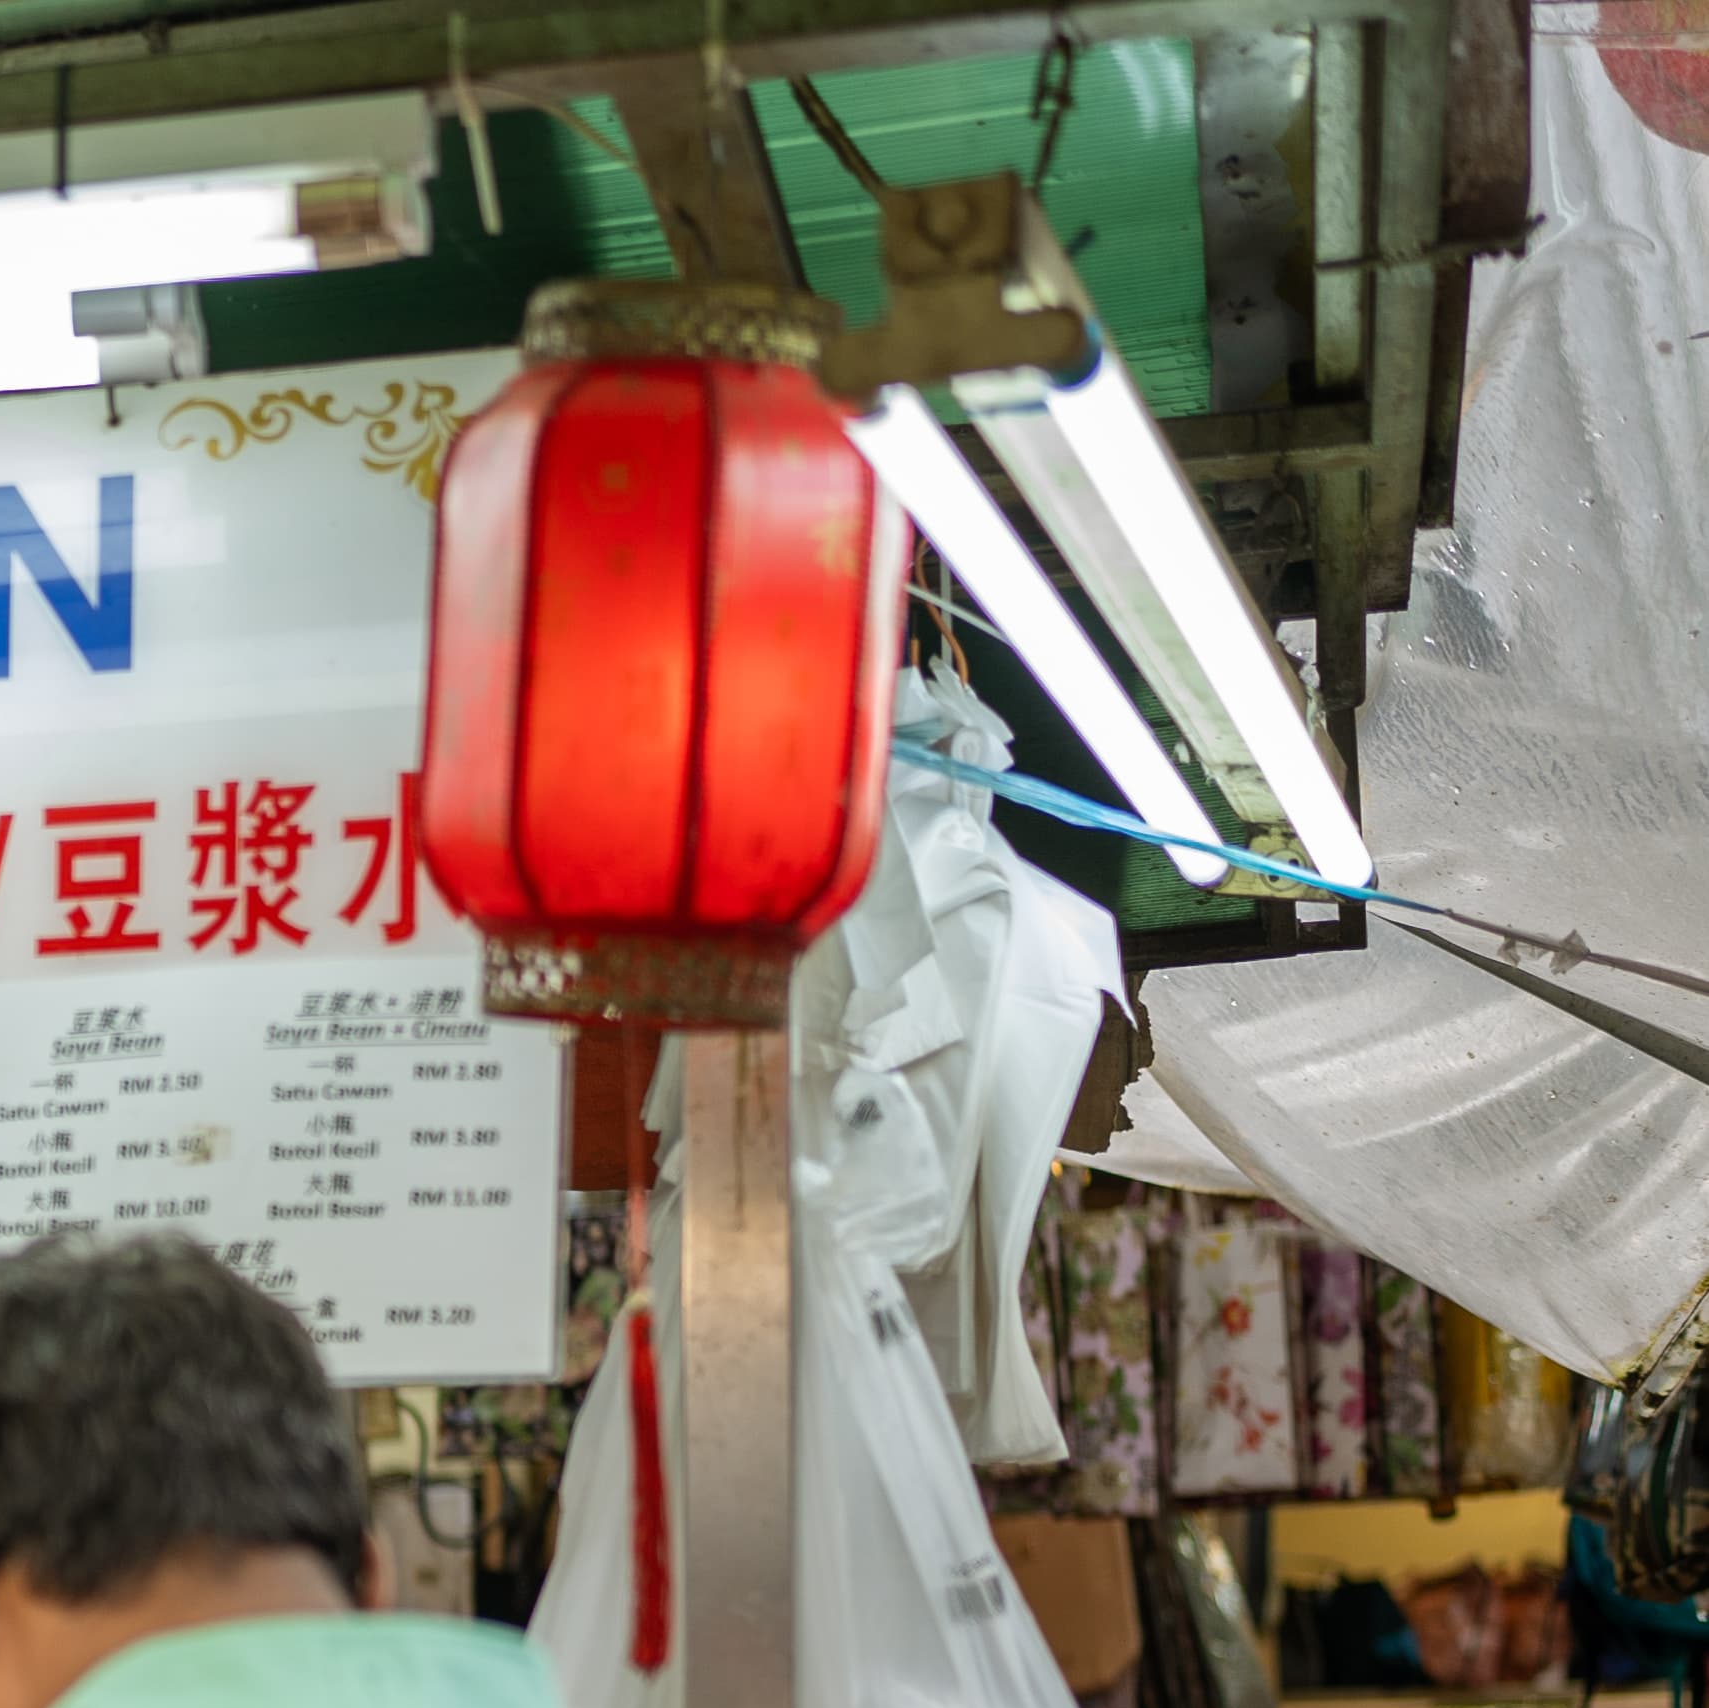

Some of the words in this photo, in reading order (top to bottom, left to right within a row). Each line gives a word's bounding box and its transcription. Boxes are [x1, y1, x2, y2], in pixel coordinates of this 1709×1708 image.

[326, 1022, 384, 1041] Bean
[50, 1038, 102, 1061] Soya
[108, 1034, 165, 1054] Bean
[413, 1062, 449, 1081] RM
[119, 1076, 153, 1096] RM
[270, 1086, 316, 1102] Satu
[321, 1084, 393, 1099] Cawan
[42, 1099, 109, 1119] Cawan
[410, 1129, 448, 1147] RM
[116, 1142, 151, 1161] RM
[269, 1143, 323, 1161] Botol
[329, 1140, 380, 1159] Kecil
[49, 1156, 95, 1176] Kecil
[408, 1188, 446, 1207] RM
[114, 1202, 149, 1220] RM
[266, 1203, 321, 1221] Botol
[328, 1202, 386, 1219] Besar
[386, 1307, 424, 1325] RM
